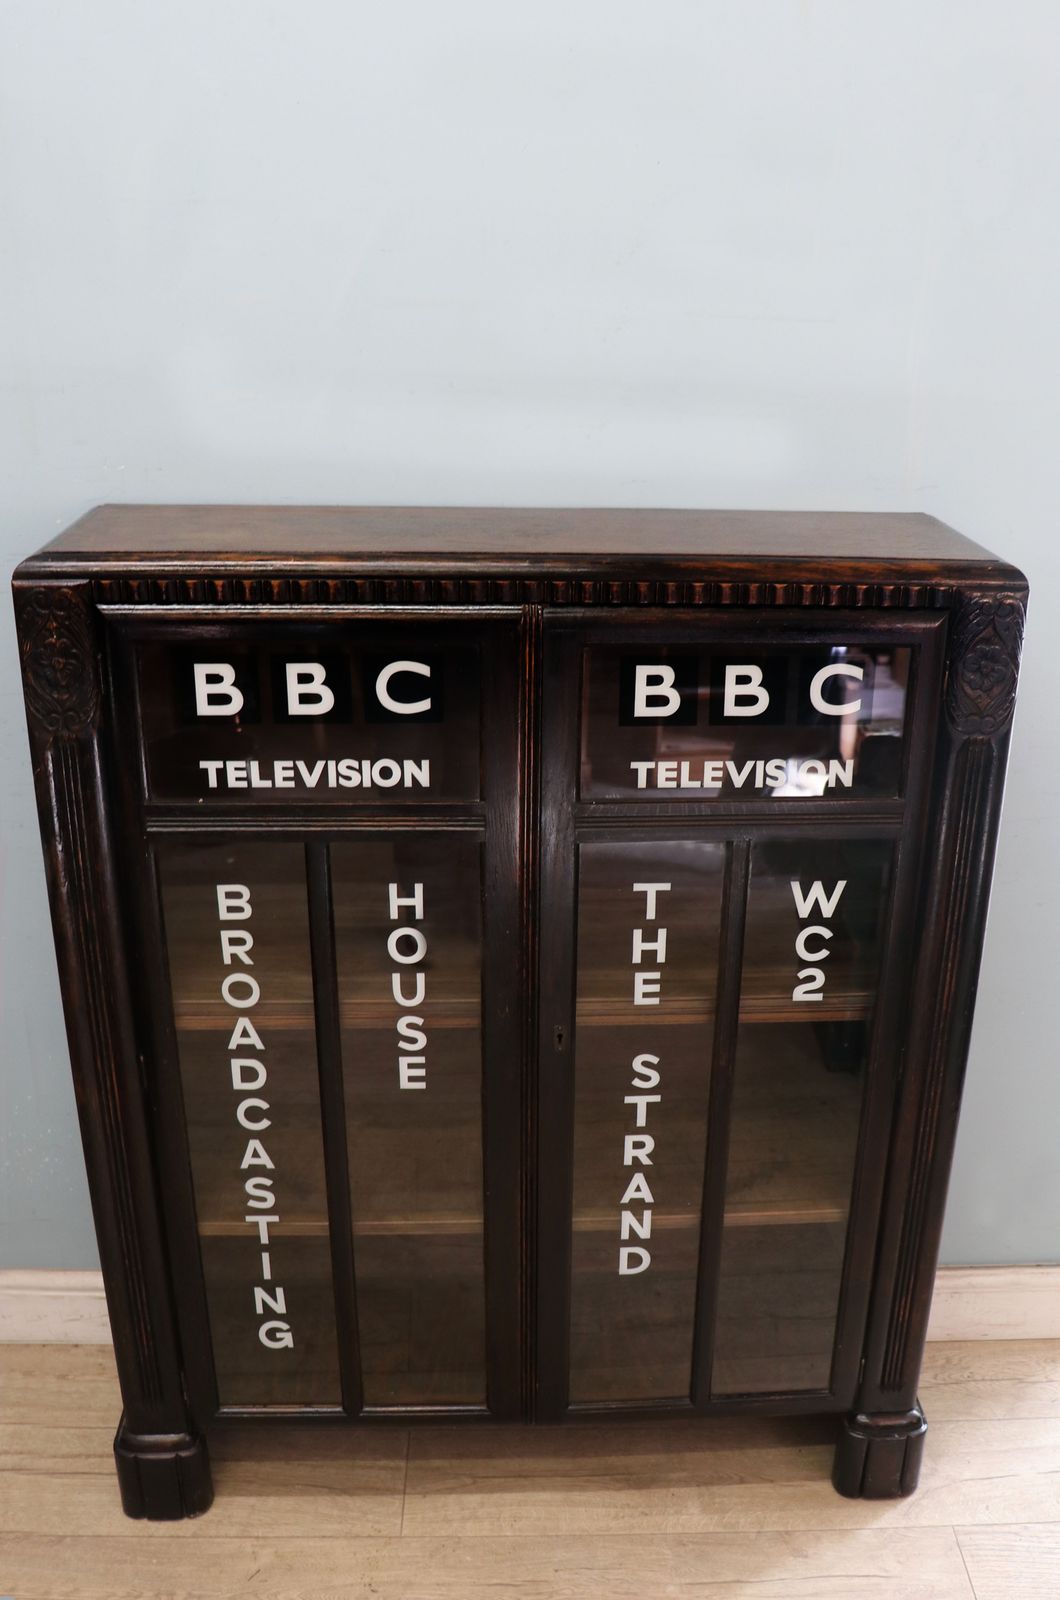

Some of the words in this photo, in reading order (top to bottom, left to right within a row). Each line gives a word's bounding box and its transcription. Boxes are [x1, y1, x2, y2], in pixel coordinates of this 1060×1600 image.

[193, 660, 432, 716] BBC
[633, 663, 864, 718] BBC
[200, 758, 430, 789] TELEVISION
[630, 758, 854, 789] TELEVISION
[387, 883, 427, 1090] HOUSE
[632, 882, 672, 1006] THE
[790, 880, 847, 1003] WC2
[216, 884, 294, 1349] BROADCASTING
[618, 1053, 662, 1276] STRAND
